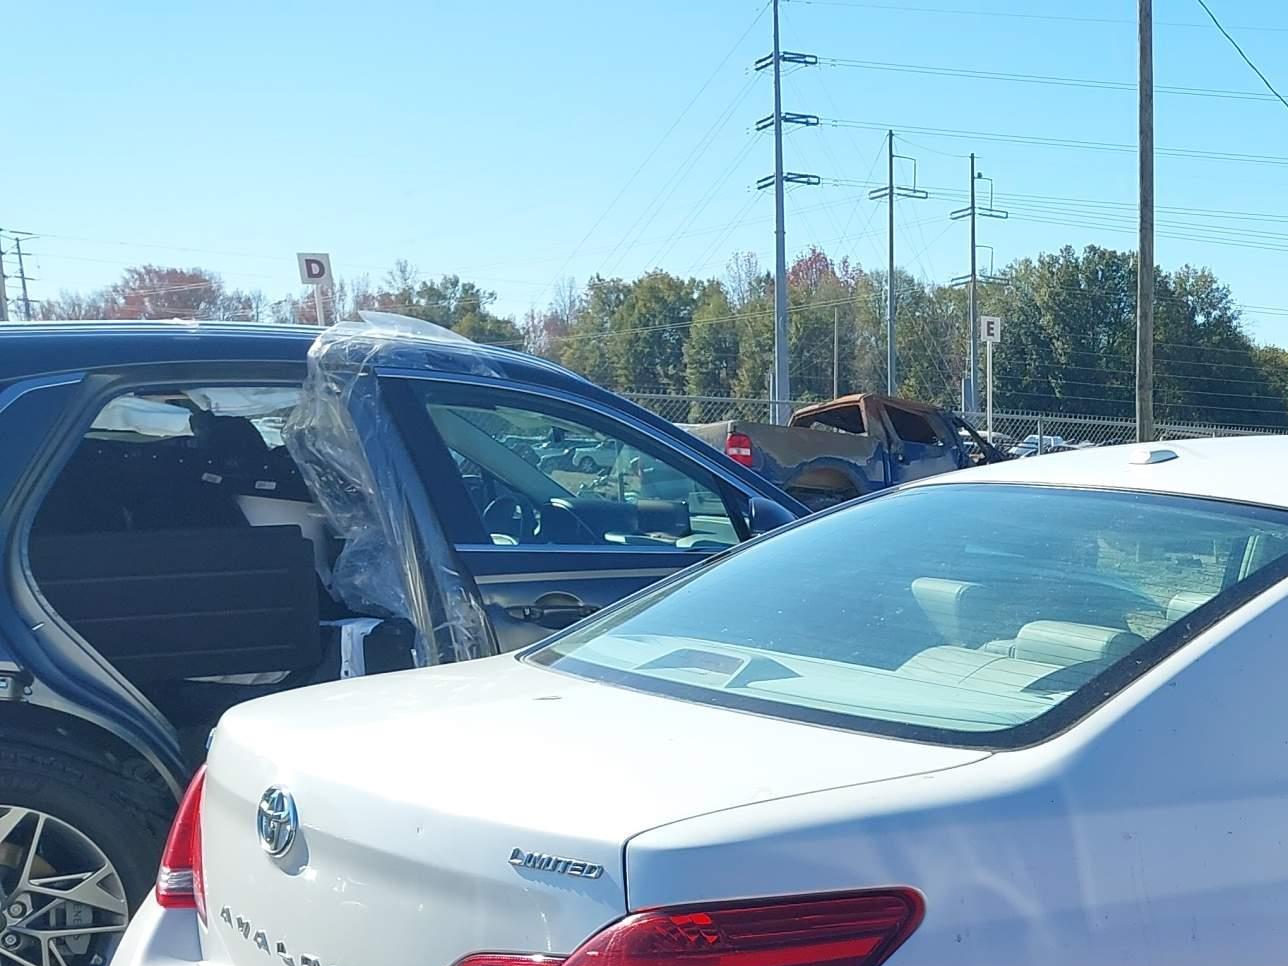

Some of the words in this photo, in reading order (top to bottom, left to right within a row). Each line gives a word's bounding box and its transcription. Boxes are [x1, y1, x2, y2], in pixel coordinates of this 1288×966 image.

[304, 259, 326, 279] D
[986, 320, 995, 337] E
[508, 847, 605, 880] LIMITED
